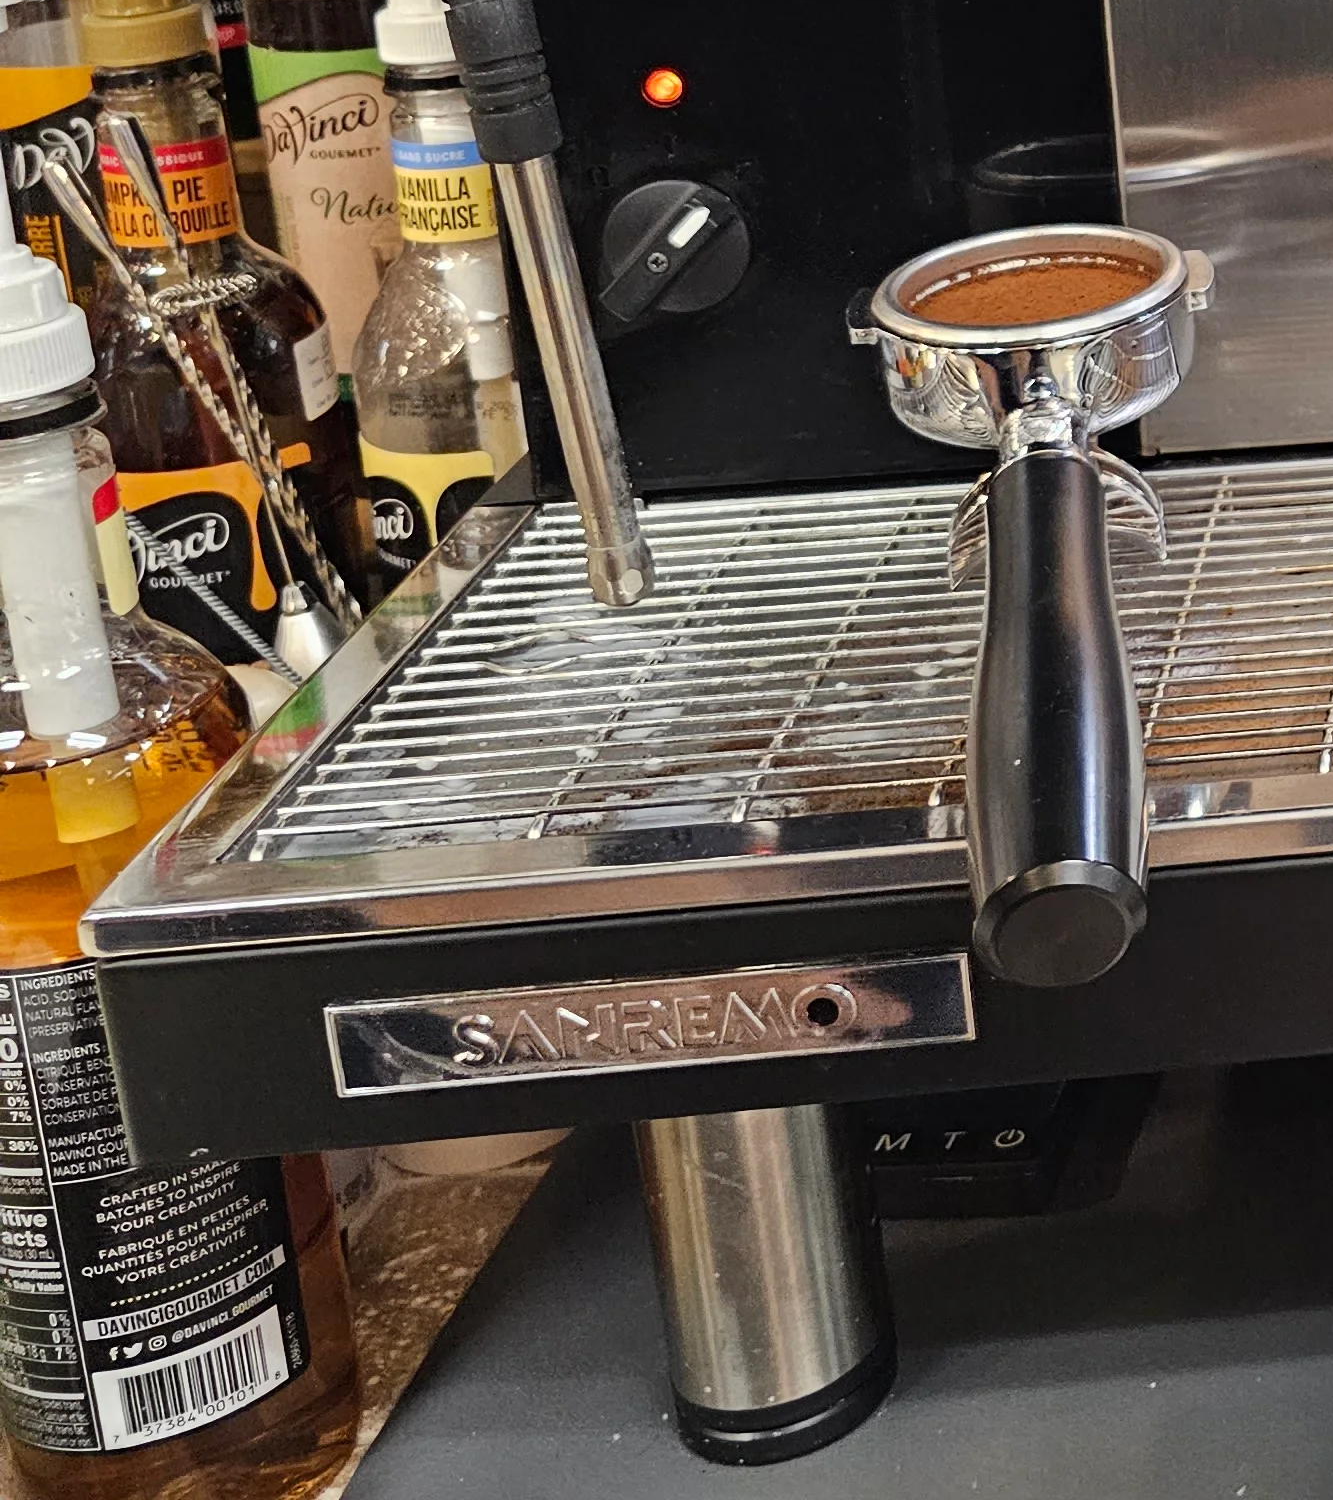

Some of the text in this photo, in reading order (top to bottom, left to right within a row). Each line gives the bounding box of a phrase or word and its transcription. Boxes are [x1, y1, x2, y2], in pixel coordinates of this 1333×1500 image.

[172, 175, 206, 205] PIE
[399, 175, 472, 202] VANILLA
[26, 1006, 75, 1023] NATURAL
[452, 982, 858, 1069] SANREMO
[4, 1079, 27, 1092] 0%
[6, 1094, 30, 1107] 0%
[42, 1093, 89, 1110] SORBATE
[93, 1089, 109, 1102] DE
[9, 1109, 32, 1122] 7%
[51, 1143, 96, 1163] DAVINCI
[874, 1130, 969, 1151] M T
[53, 1153, 129, 1177] MADE IN THE
[95, 1161, 241, 1224] BATCHES TO INSPIRE
[99, 1179, 169, 1208] CRAFTED
[172, 1172, 188, 1187] IN
[111, 1179, 236, 1235] YOUR CREATIVITY
[98, 1194, 250, 1260] FABRIQUÉ EN PETITES
[81, 1249, 165, 1279] QUANTITÉS
[167, 1231, 208, 1256] POUR
[116, 1225, 247, 1285] VOTRE CRÉATIVITÉ
[97, 1252, 276, 1338] DAVINCIGOURMET.COM
[171, 1283, 275, 1344] @DAVINCI_GOURMET
[112, 1434, 120, 1444] 7
[143, 1412, 198, 1438] 37384
[205, 1385, 257, 1418] 00101
[274, 1370, 282, 1381] 8
